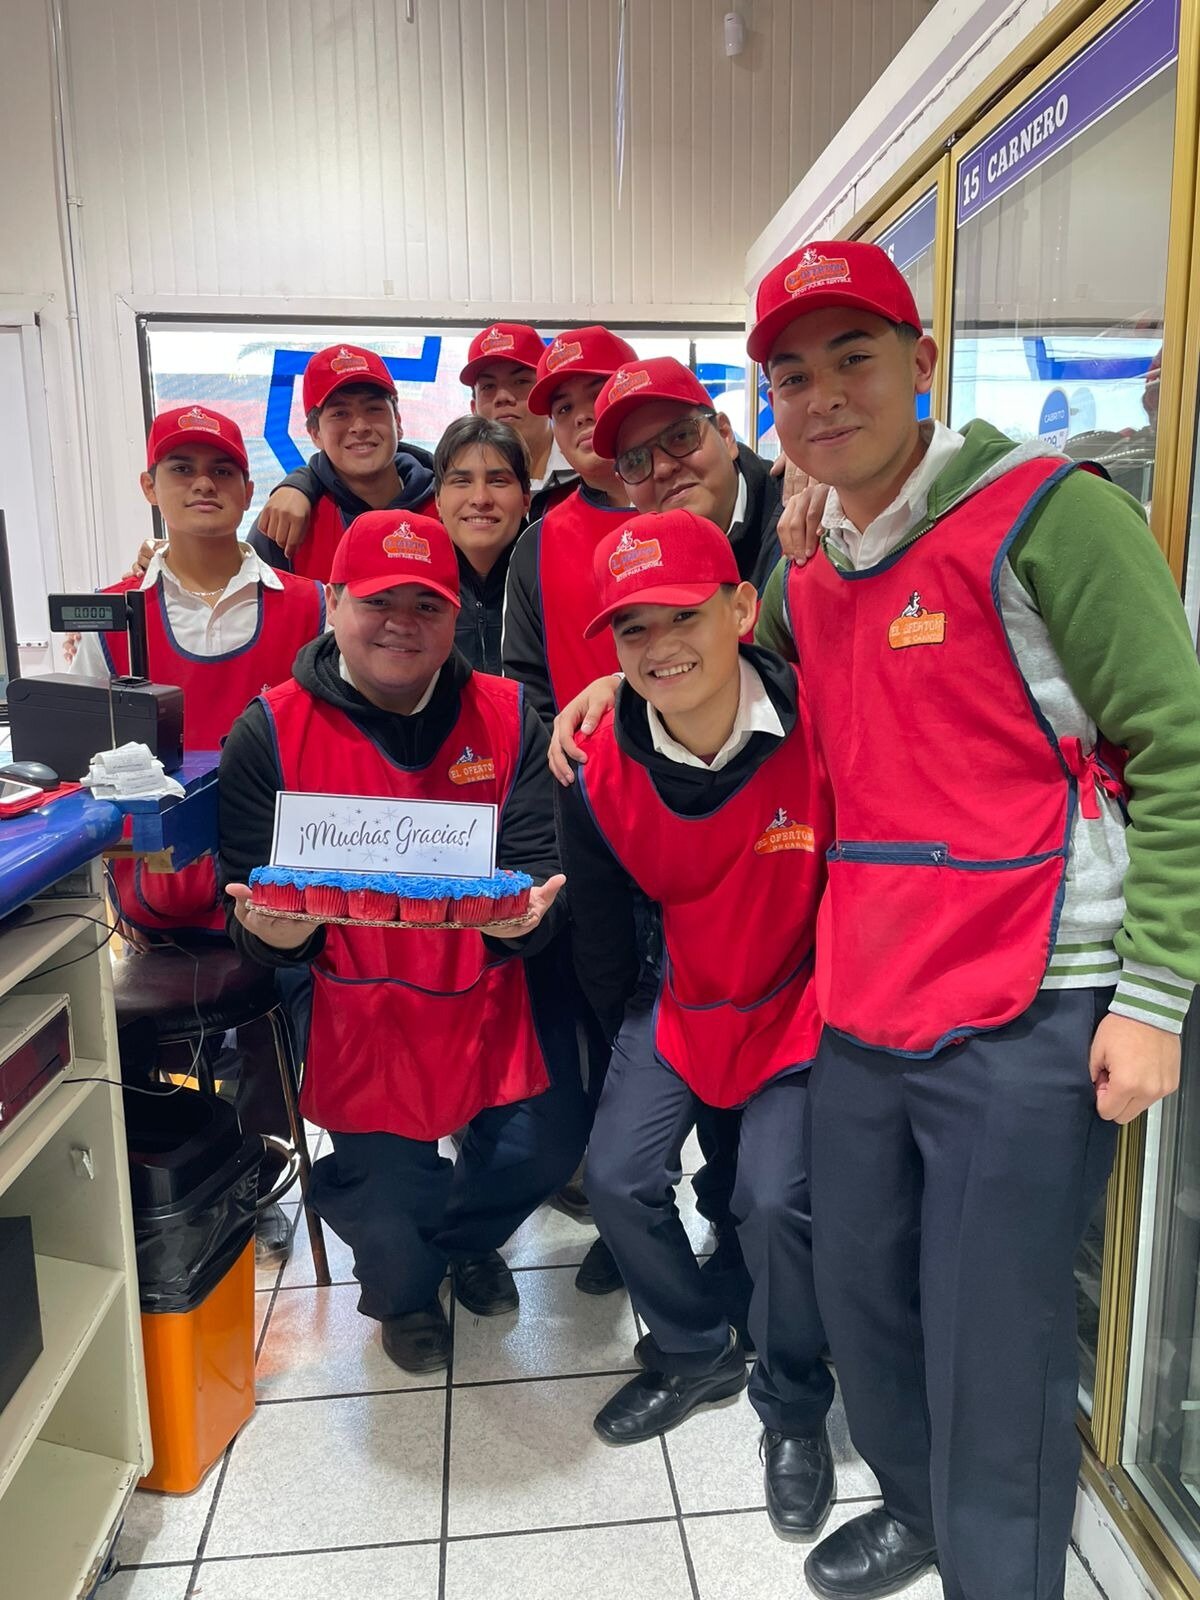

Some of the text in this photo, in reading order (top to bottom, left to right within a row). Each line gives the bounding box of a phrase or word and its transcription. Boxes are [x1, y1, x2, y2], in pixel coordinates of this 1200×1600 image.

[963, 94, 1069, 206] 15 CARNERO
[1044, 409, 1066, 424] CABRITO
[891, 625, 901, 636] EL
[451, 763, 494, 778] EL OFERTO
[299, 815, 477, 855] ¡Muchas Gracias!
